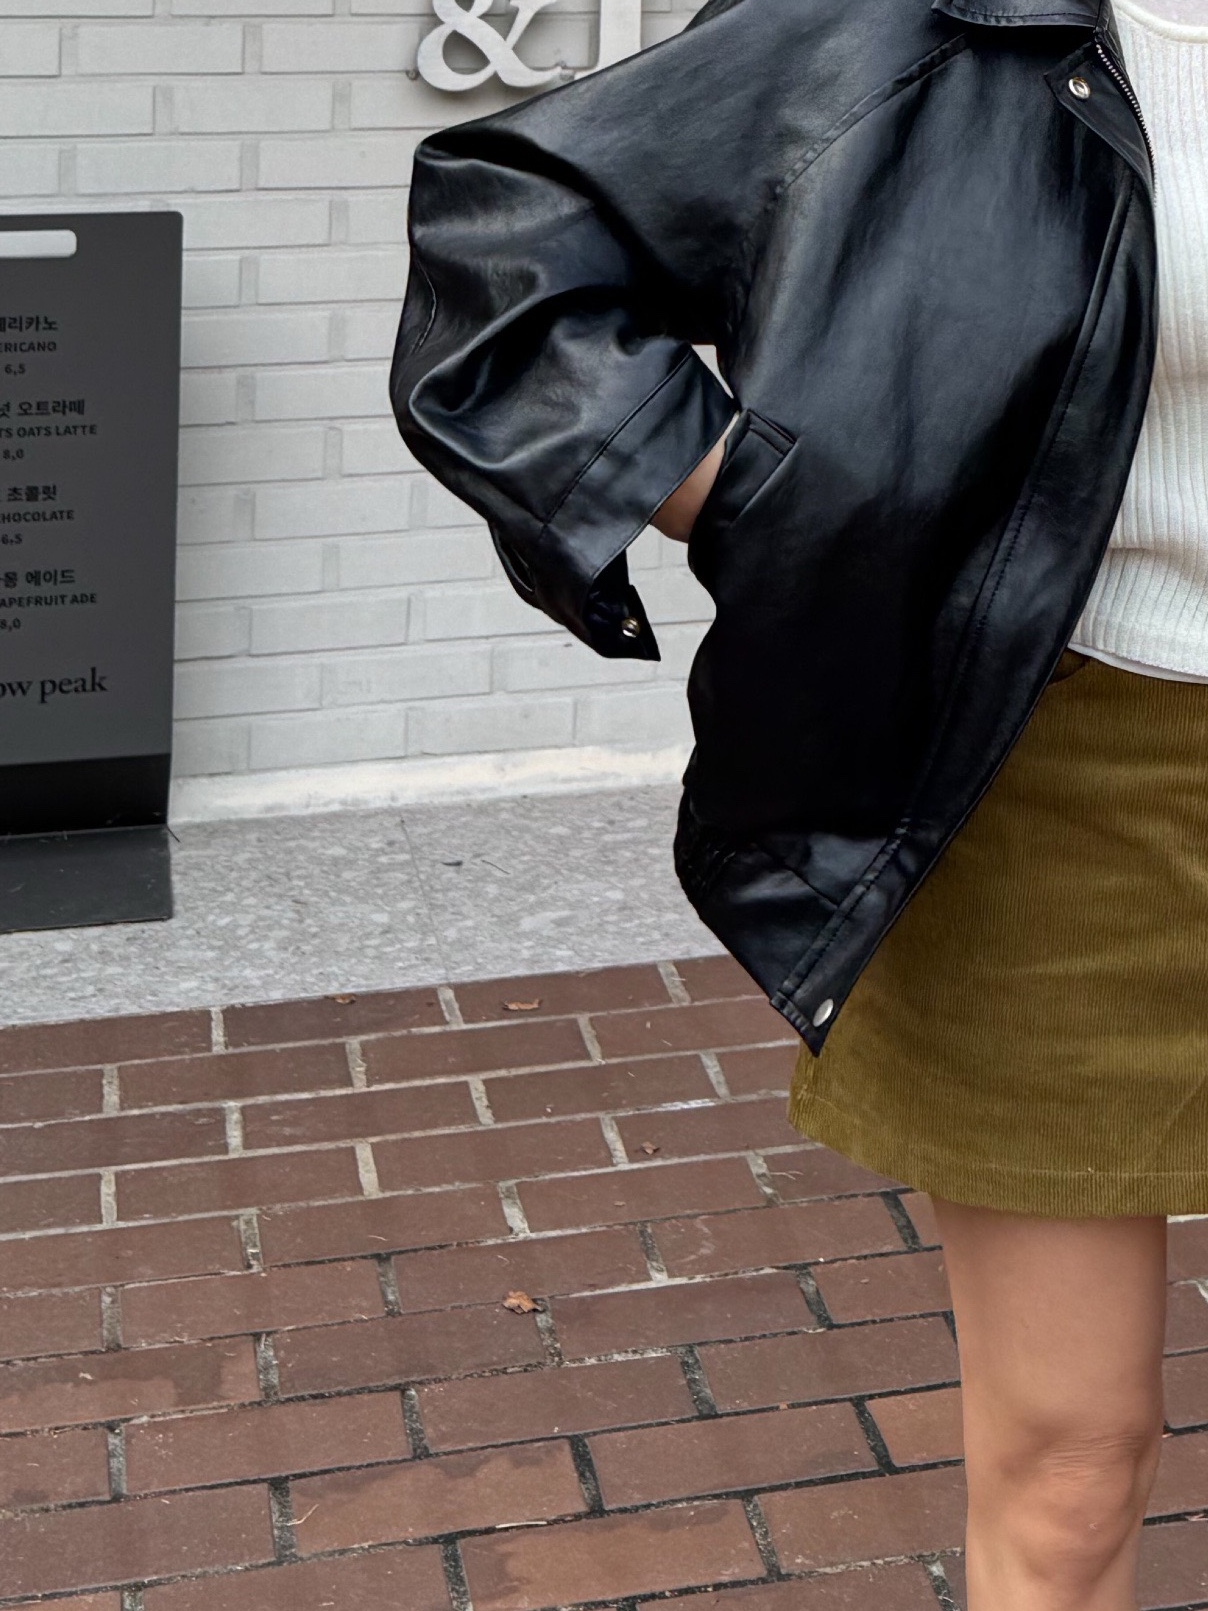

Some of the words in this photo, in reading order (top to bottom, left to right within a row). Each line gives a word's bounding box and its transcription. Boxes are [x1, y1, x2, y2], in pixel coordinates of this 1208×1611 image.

[17, 425, 52, 438] OATS
[55, 424, 97, 437] LATTE
[0, 510, 75, 524] HOCOLATE
[25, 569, 76, 586] 에이드
[70, 593, 97, 605] ADE
[39, 666, 109, 704] peak
